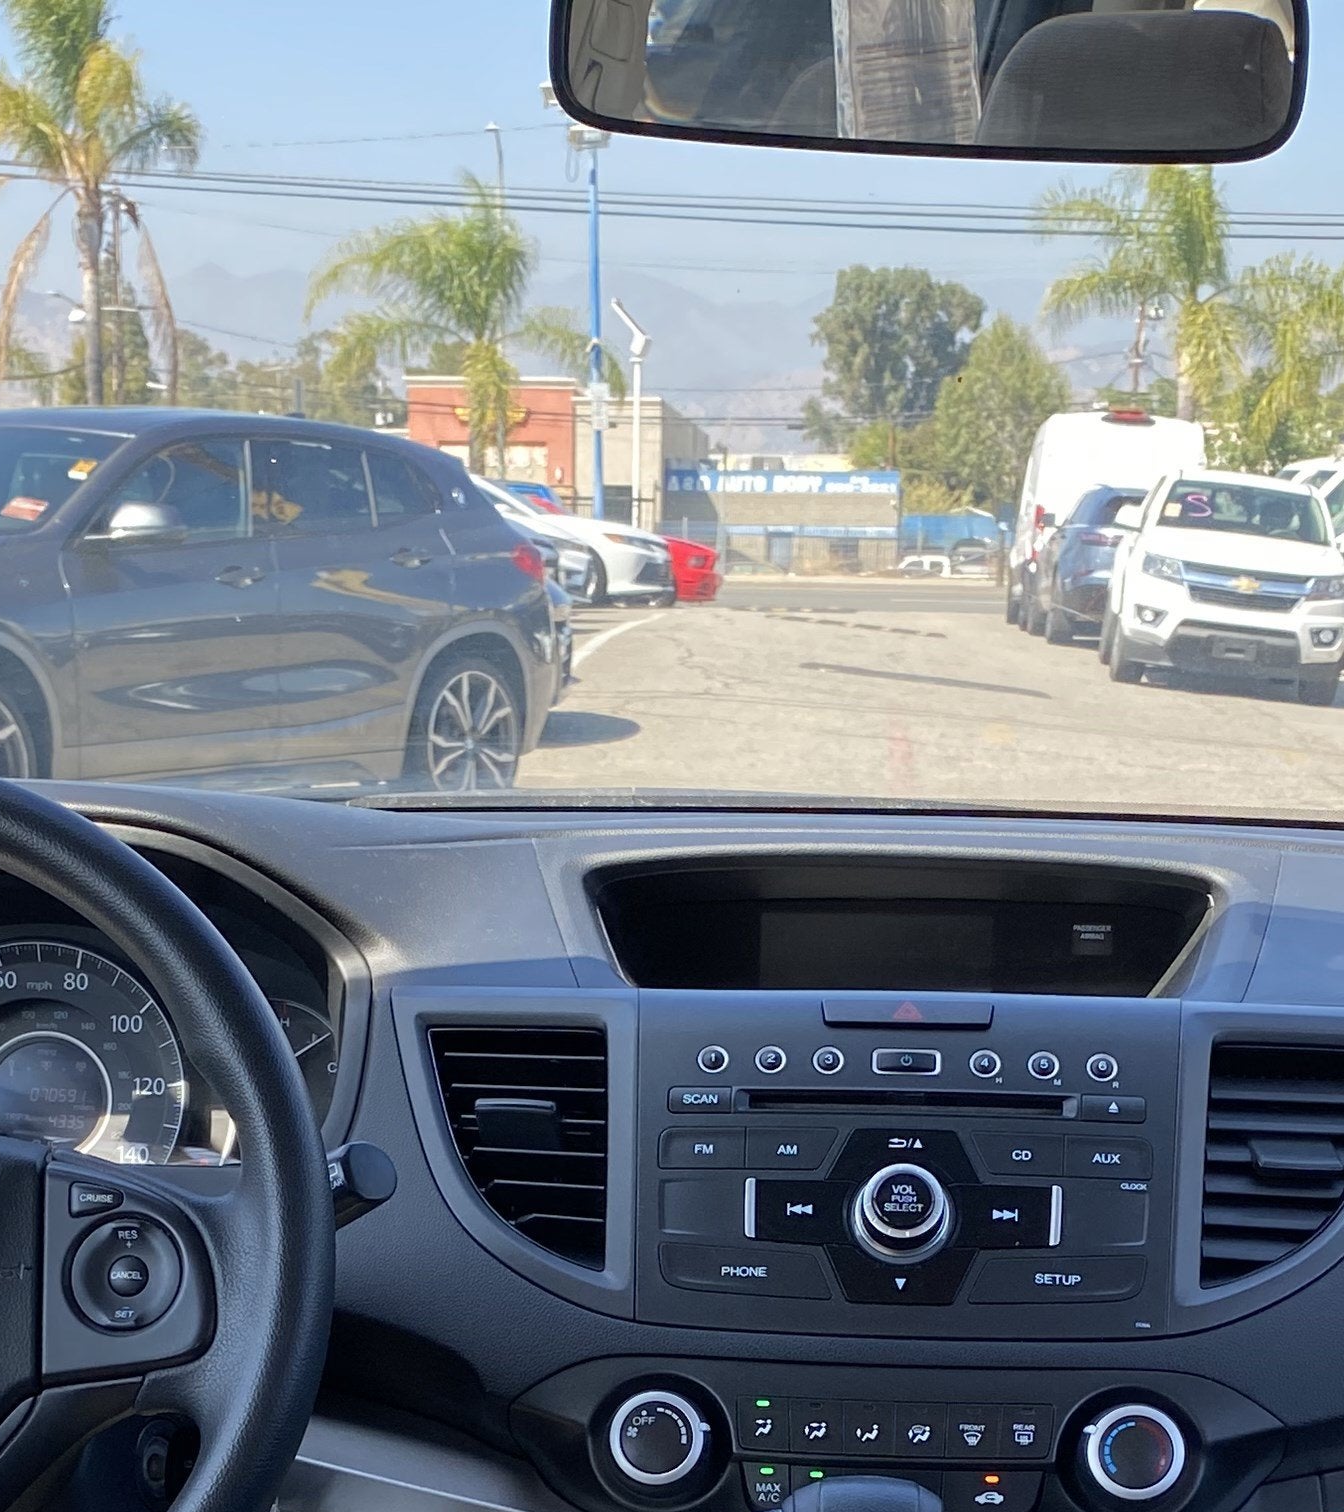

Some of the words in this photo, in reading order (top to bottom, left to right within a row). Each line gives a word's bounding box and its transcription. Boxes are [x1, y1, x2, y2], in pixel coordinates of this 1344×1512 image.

[717, 475, 767, 492] AUTO
[772, 475, 823, 493] BODY
[26, 980, 53, 993] mph
[63, 973, 89, 991] 80
[110, 1014, 143, 1033] 100
[280, 1017, 290, 1028] H
[709, 1053, 716, 1063] 1
[766, 1053, 776, 1063] 2
[824, 1053, 833, 1064] 3
[980, 1058, 989, 1068] 4
[1040, 1058, 1049, 1069] 5
[327, 1062, 338, 1073] C
[1098, 1061, 1107, 1071] 6
[133, 1077, 165, 1096] 120
[682, 1093, 719, 1104] SCAN
[117, 1145, 150, 1164] 140
[694, 1143, 714, 1155] FM
[776, 1144, 798, 1155] AM
[1011, 1150, 1032, 1161] CD
[1092, 1153, 1121, 1164] AUX
[891, 1184, 916, 1196] VOL
[1120, 1182, 1148, 1191] CLOCK
[79, 1193, 113, 1203] CRUISE
[891, 1195, 917, 1203] PUSH
[883, 1202, 924, 1213] SELECT
[118, 1230, 138, 1240] RES
[110, 1270, 142, 1280] CANCEL
[720, 1266, 768, 1278] PHONE
[1034, 1273, 1082, 1286] SETUP
[114, 1310, 135, 1318] SET
[632, 1416, 656, 1426] OFF
[959, 1423, 986, 1433] FRONT
[1012, 1423, 1035, 1432] REAR
[755, 1482, 781, 1493] MAX
[757, 1492, 780, 1503] A/C
